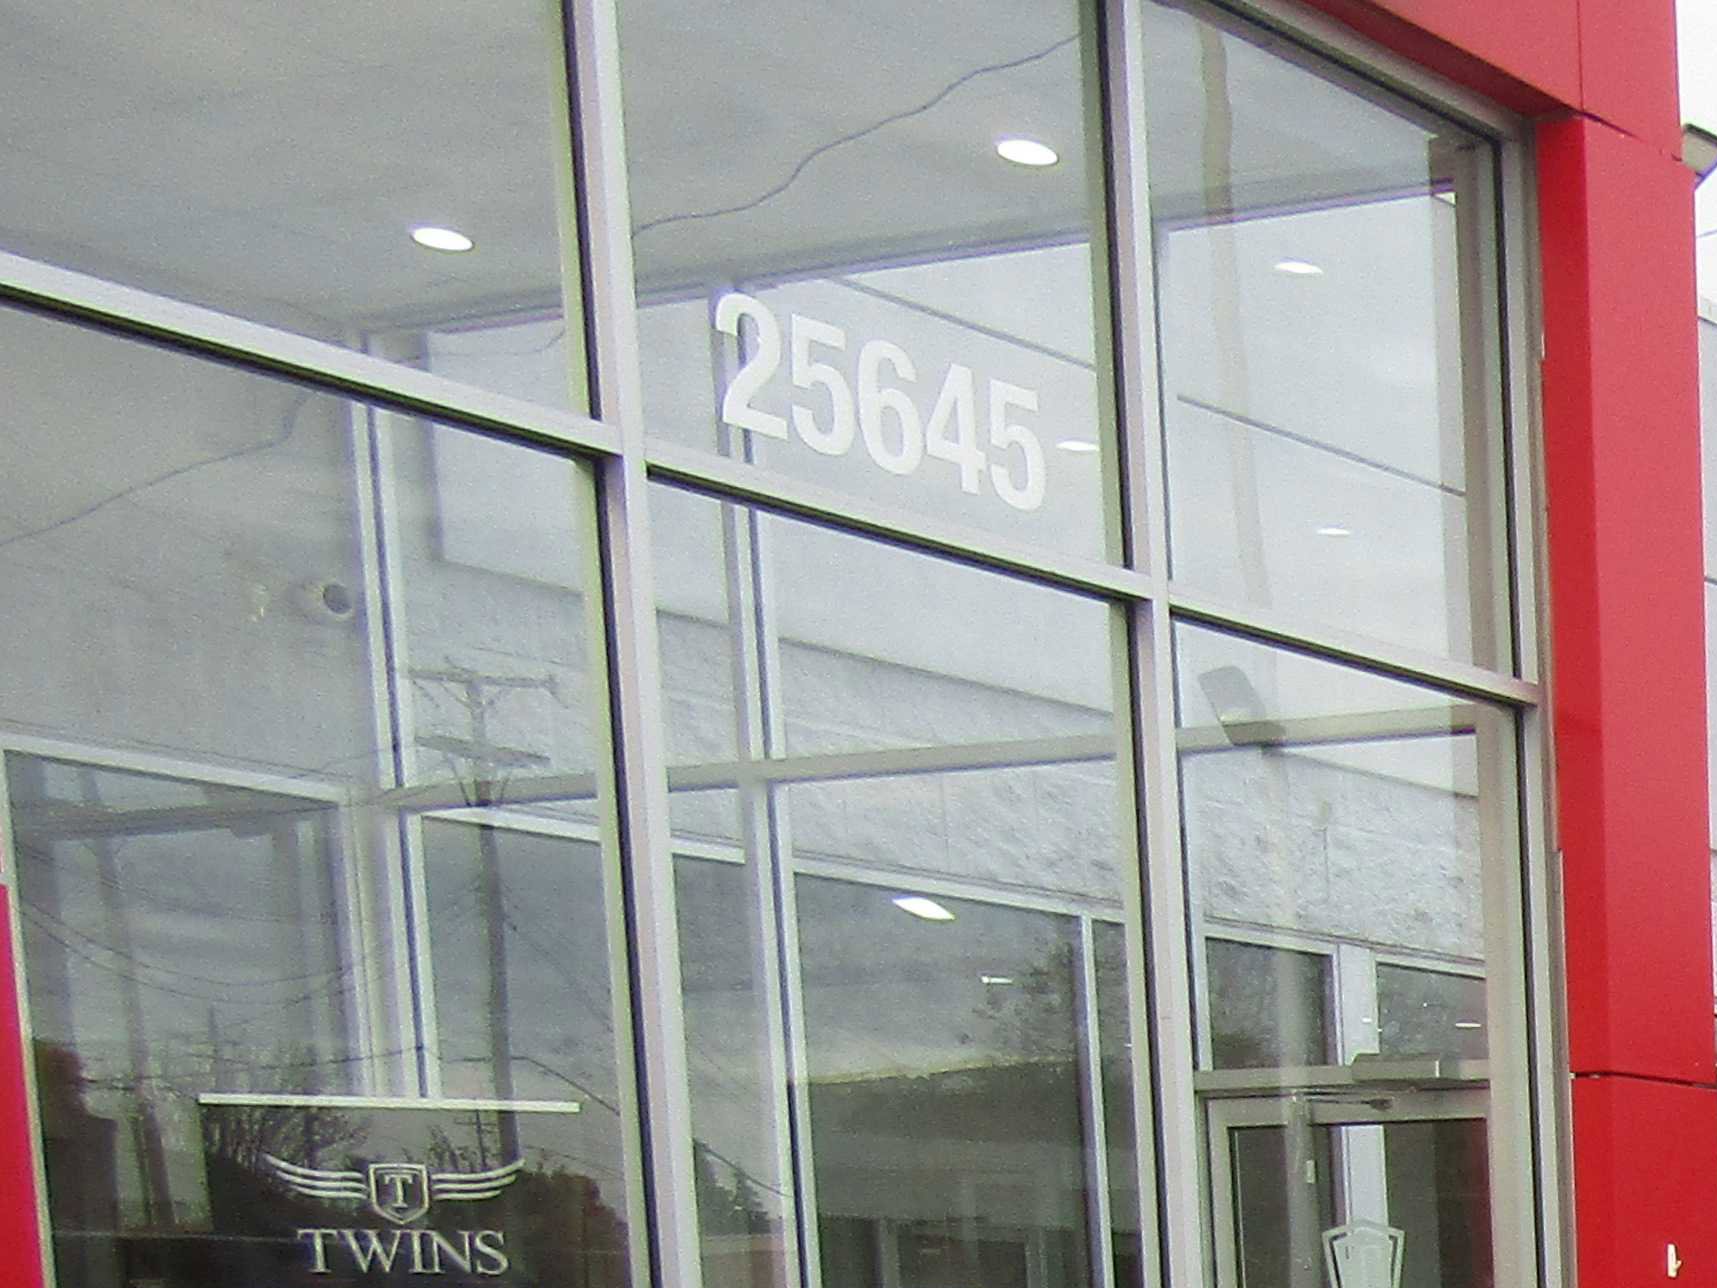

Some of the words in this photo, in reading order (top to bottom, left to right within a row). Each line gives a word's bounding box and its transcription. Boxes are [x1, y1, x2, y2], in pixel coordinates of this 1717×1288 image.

[714, 293, 1047, 511] 25645
[384, 1173, 413, 1208] T
[297, 1229, 510, 1277] TWINS
